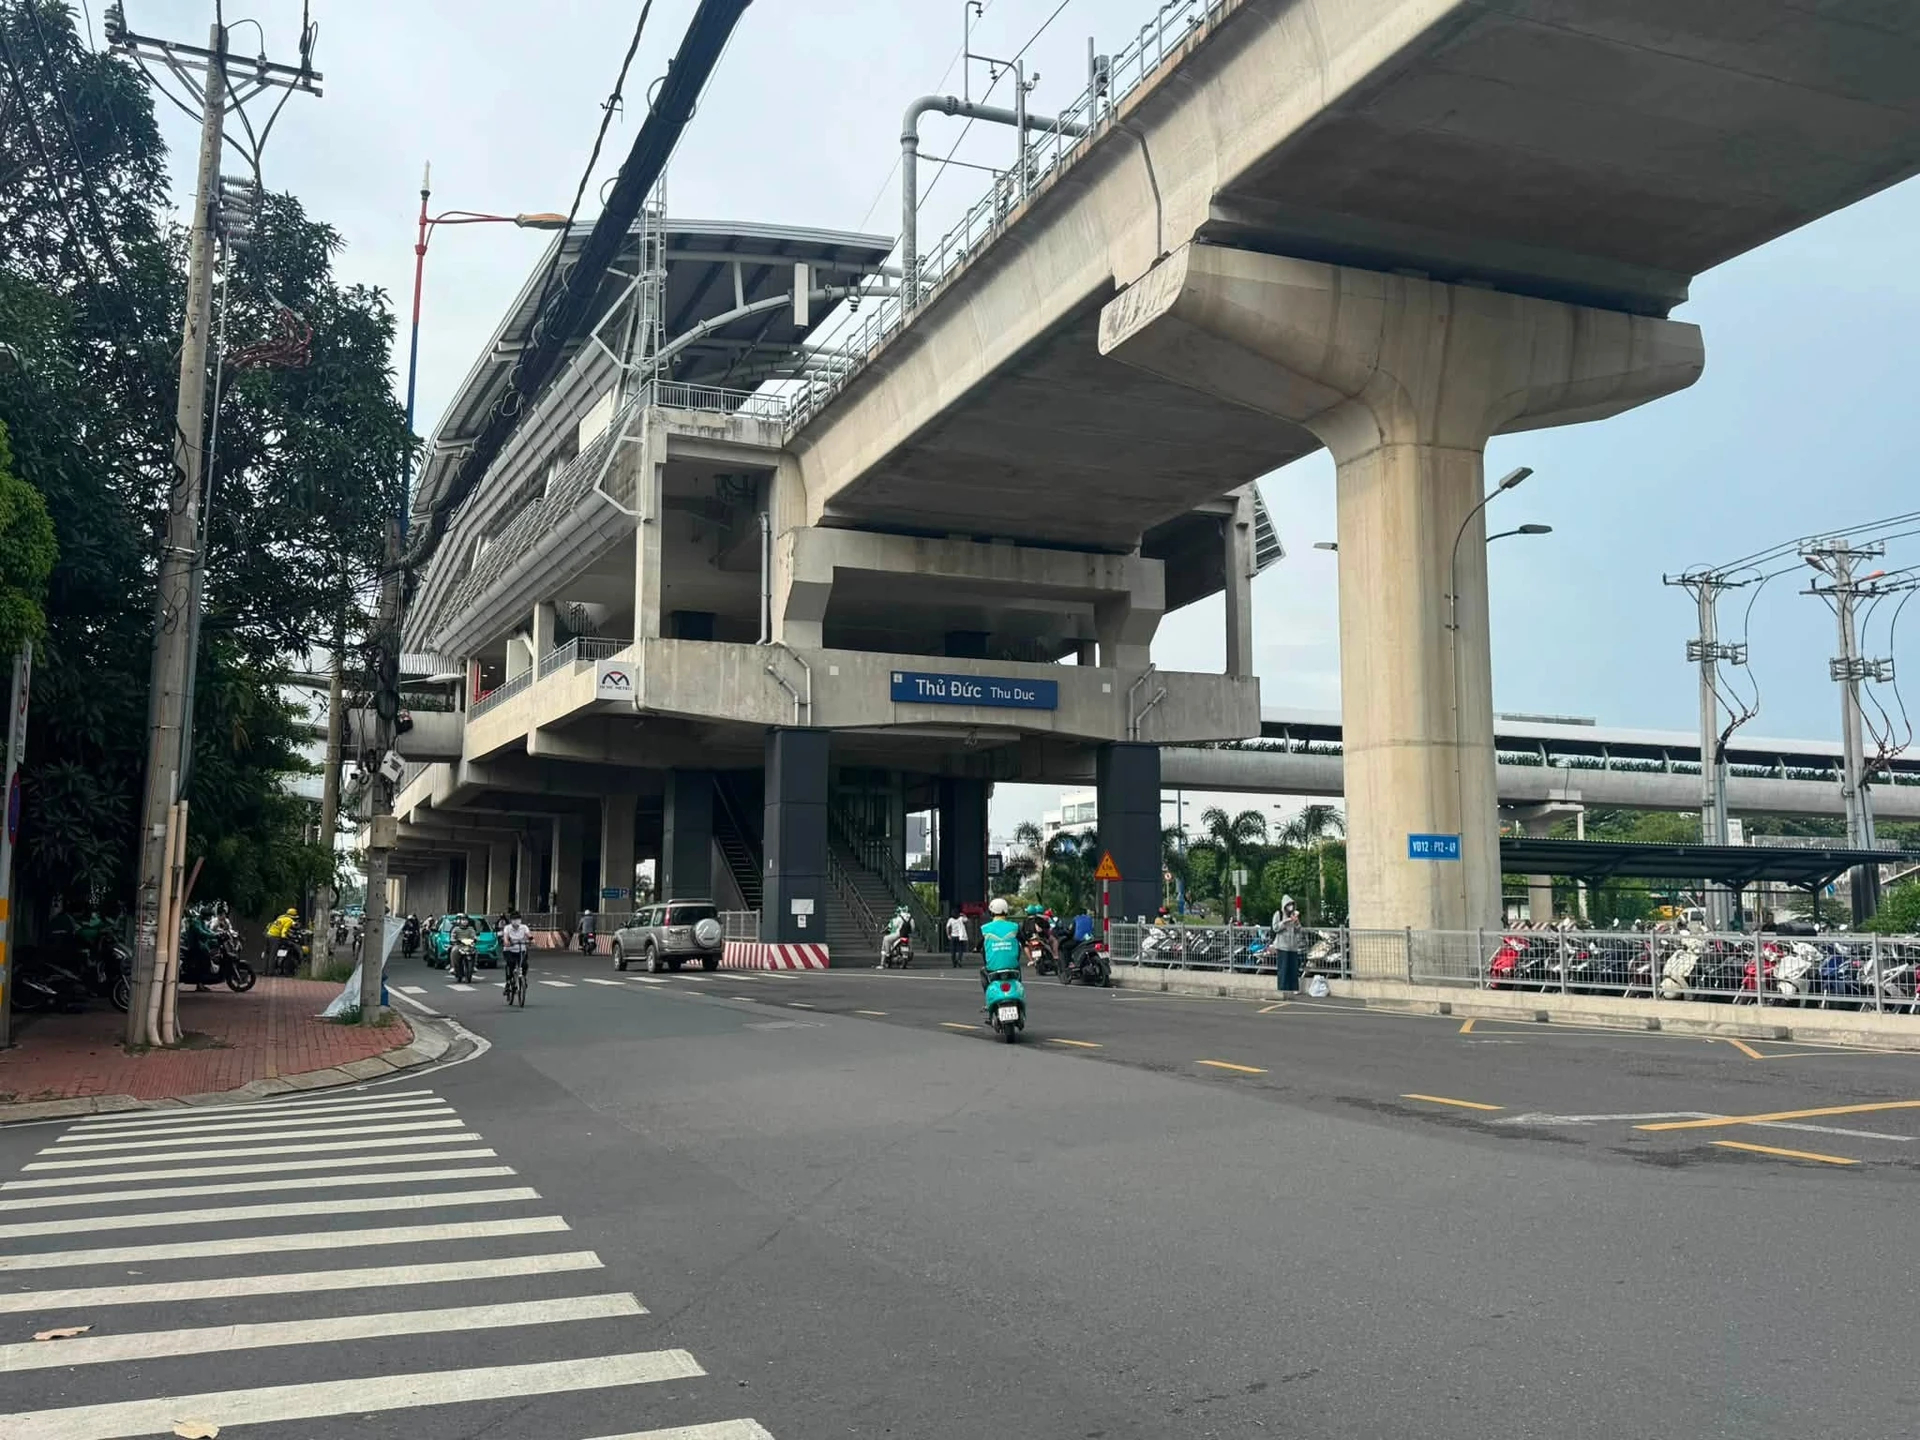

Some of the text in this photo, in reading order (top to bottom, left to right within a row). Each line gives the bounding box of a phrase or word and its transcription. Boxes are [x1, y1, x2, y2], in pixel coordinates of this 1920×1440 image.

[915, 678, 1035, 700] Thủ Đức Thu Duc
